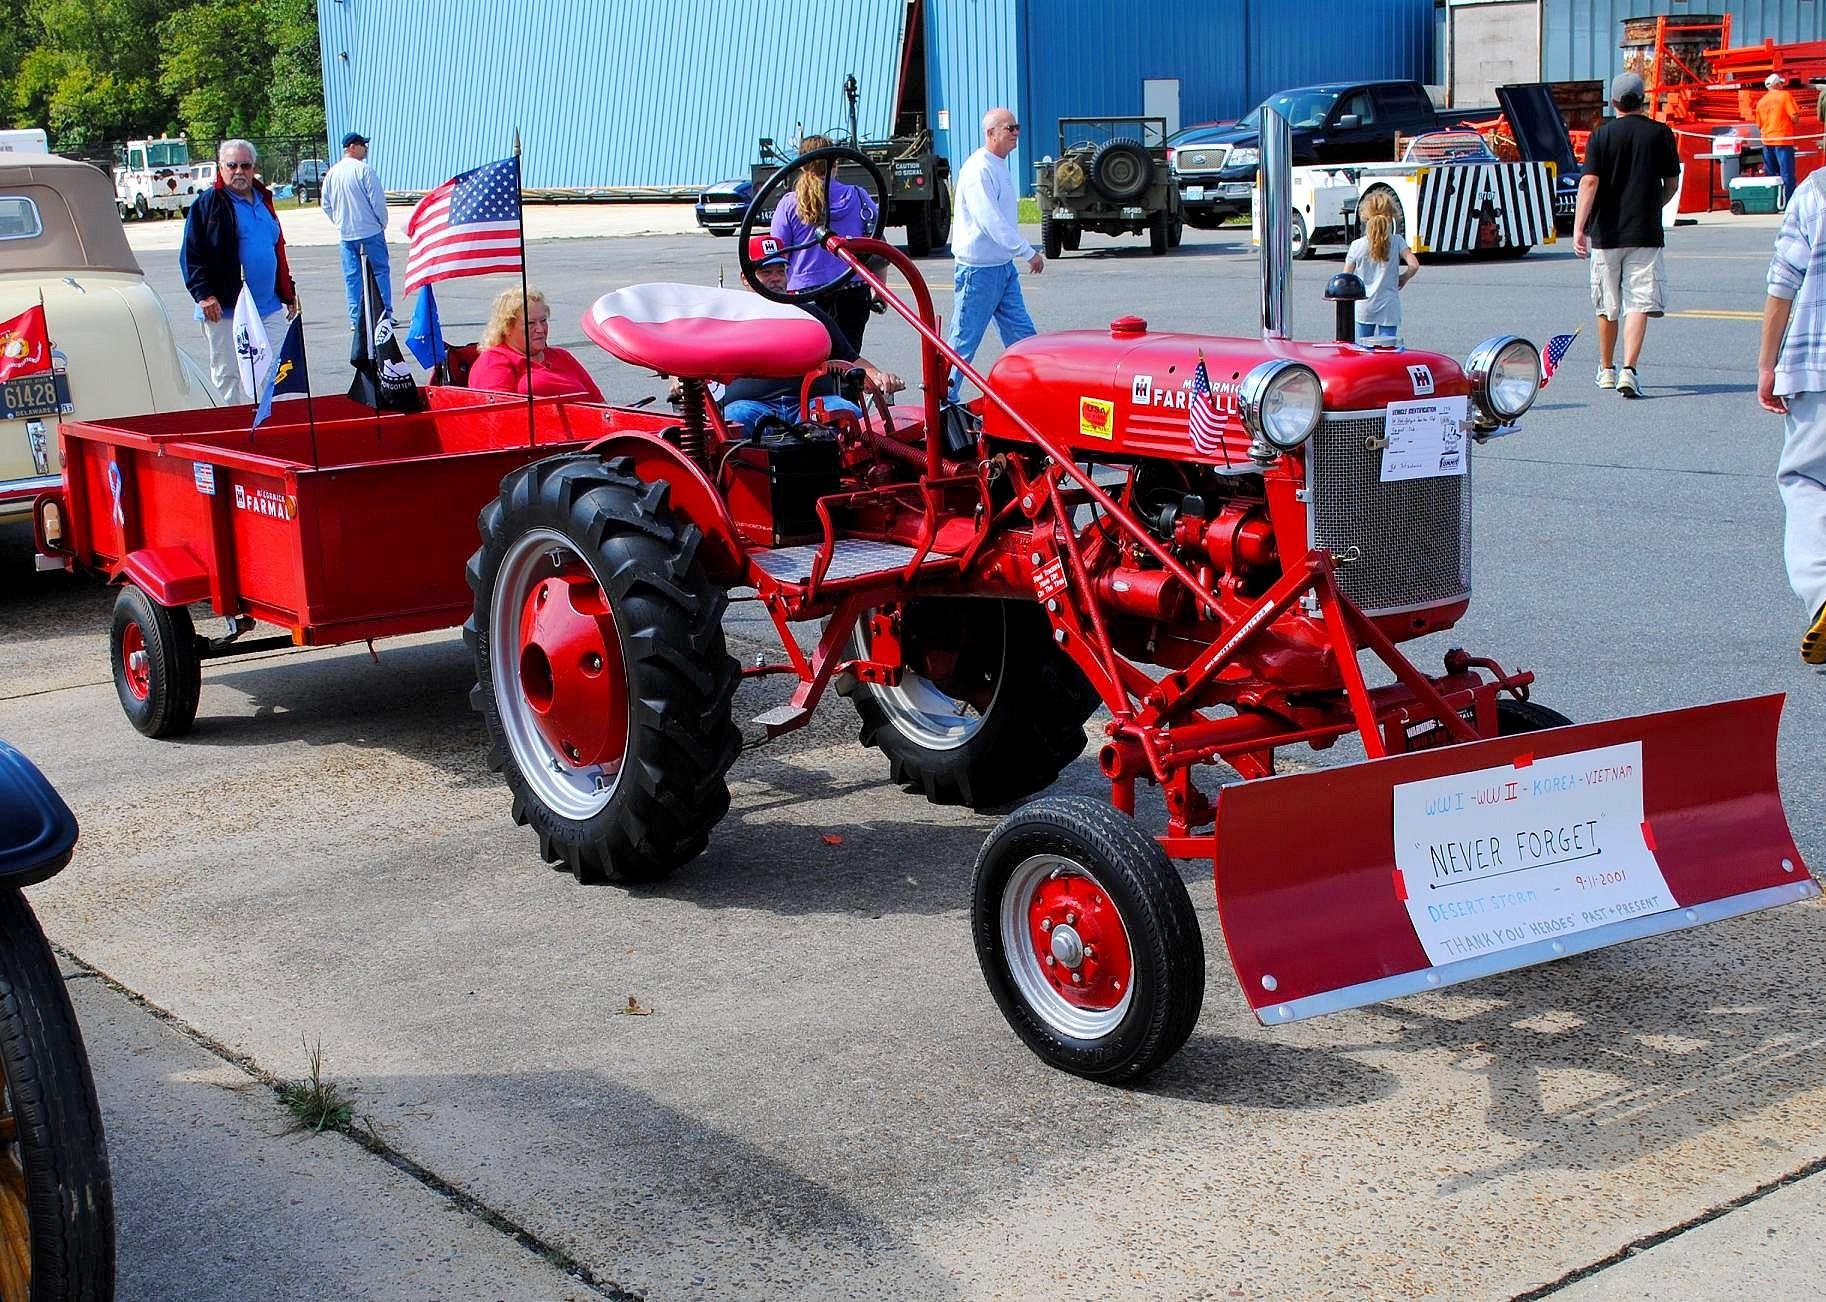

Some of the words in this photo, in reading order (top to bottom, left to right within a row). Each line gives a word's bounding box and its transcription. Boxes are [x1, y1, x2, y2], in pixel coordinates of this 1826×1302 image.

[895, 162, 920, 170] CAUTION
[903, 169, 923, 177] SIGNAL
[4, 383, 57, 409] 61428
[15, 407, 51, 417] DELAWARE
[1087, 404, 1107, 415] USA
[1427, 897, 1485, 923] DESERT
[1490, 890, 1538, 910] STORM
[1440, 932, 1494, 956] THANK
[1493, 924, 1525, 944] YOU
[1581, 907, 1609, 924] PAST
[1615, 895, 1660, 916] PRESENT
